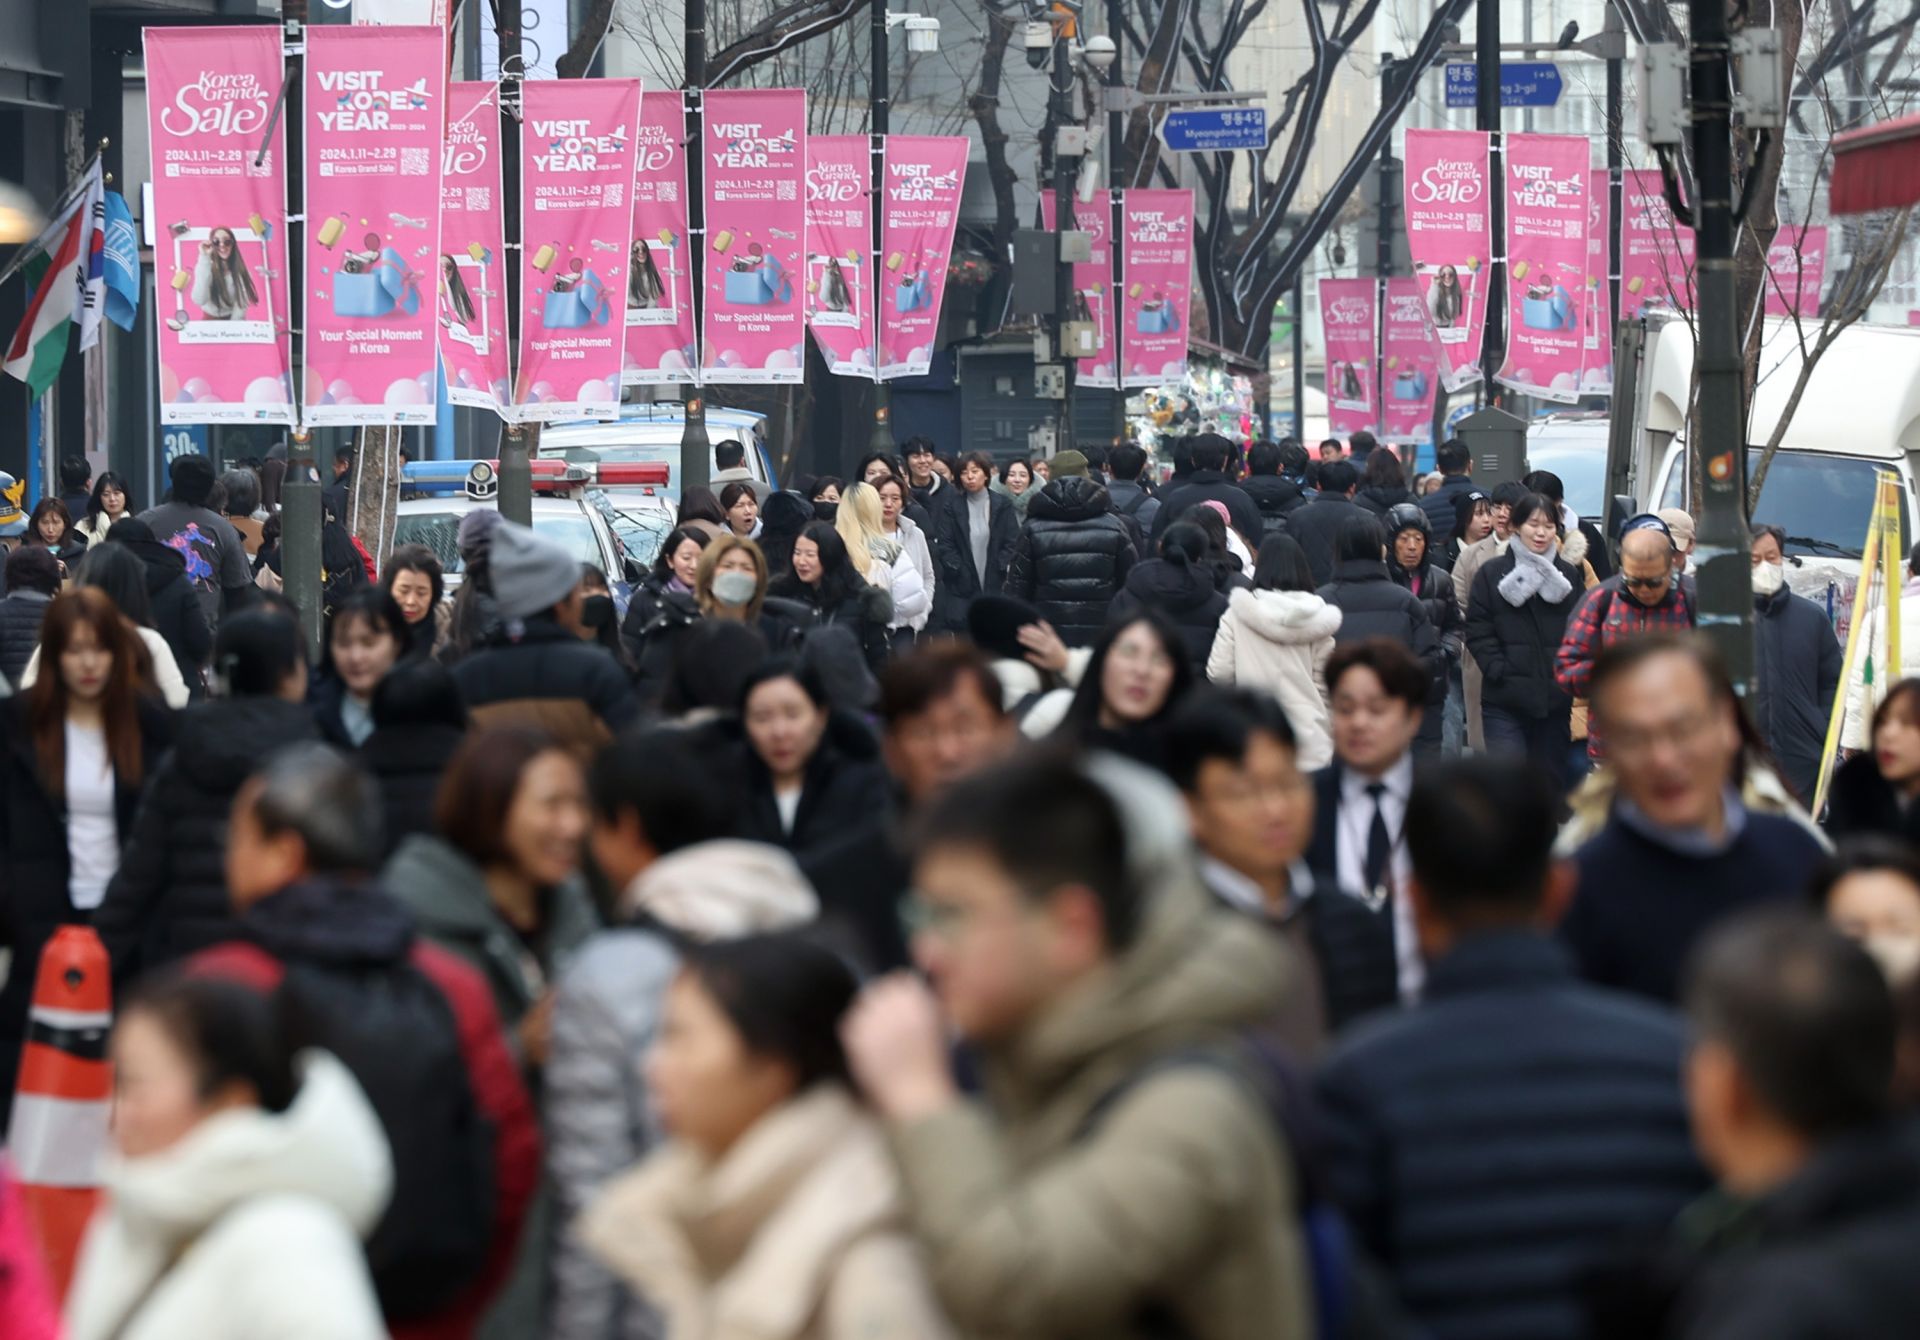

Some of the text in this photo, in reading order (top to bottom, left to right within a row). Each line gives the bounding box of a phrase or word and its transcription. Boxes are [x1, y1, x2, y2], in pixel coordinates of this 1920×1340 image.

[199, 70, 256, 88] Korea
[317, 71, 383, 91] VISIT
[203, 85, 260, 101] Grand
[337, 89, 428, 111] KOREA
[161, 84, 269, 136] Sale
[317, 112, 390, 132] YEAR
[1221, 111, 1263, 127] 명동4길
[531, 120, 591, 137] VISIT
[640, 126, 664, 136] rea
[712, 124, 762, 138] VISIT
[1185, 129, 1242, 138] Myeongdong
[447, 130, 479, 144] and
[549, 136, 625, 154] KOREA
[727, 138, 795, 153] KOREA
[165, 150, 242, 161] 2024.1.11~2.29
[320, 148, 397, 160] 2024.1.11~2.29
[442, 136, 487, 176] le
[637, 138, 674, 172] le
[712, 153, 768, 168] YEAR
[334, 163, 395, 174] Korea Grand Sale
[532, 154, 597, 172] YEAR
[818, 161, 853, 173] Korea
[1437, 158, 1473, 171] Korea
[180, 165, 241, 175] Korea Grand Sale
[890, 164, 931, 176] VISIT
[1439, 168, 1476, 180] Grand
[1512, 164, 1553, 180] VISIT
[535, 185, 601, 196] 2024.1.11~2.29
[715, 180, 775, 189] 2024.1.11~2.29
[806, 169, 861, 202] Sale
[1411, 167, 1482, 204] Sale
[889, 188, 933, 201] YEAR
[1512, 190, 1557, 208] YEAR
[1129, 211, 1164, 222] VISIT
[1130, 231, 1167, 242] YEAR
[714, 313, 794, 324] Your Special Moment
[738, 323, 771, 332] in Korea
[319, 329, 423, 343] Your Special Moment
[1530, 335, 1554, 346] Special
[1554, 338, 1578, 348] Moment
[350, 343, 390, 354] in Korea
[531, 340, 549, 350] Your
[578, 338, 612, 348] Moment
[1541, 346, 1559, 355] Korea
[551, 350, 585, 360] in Korea
